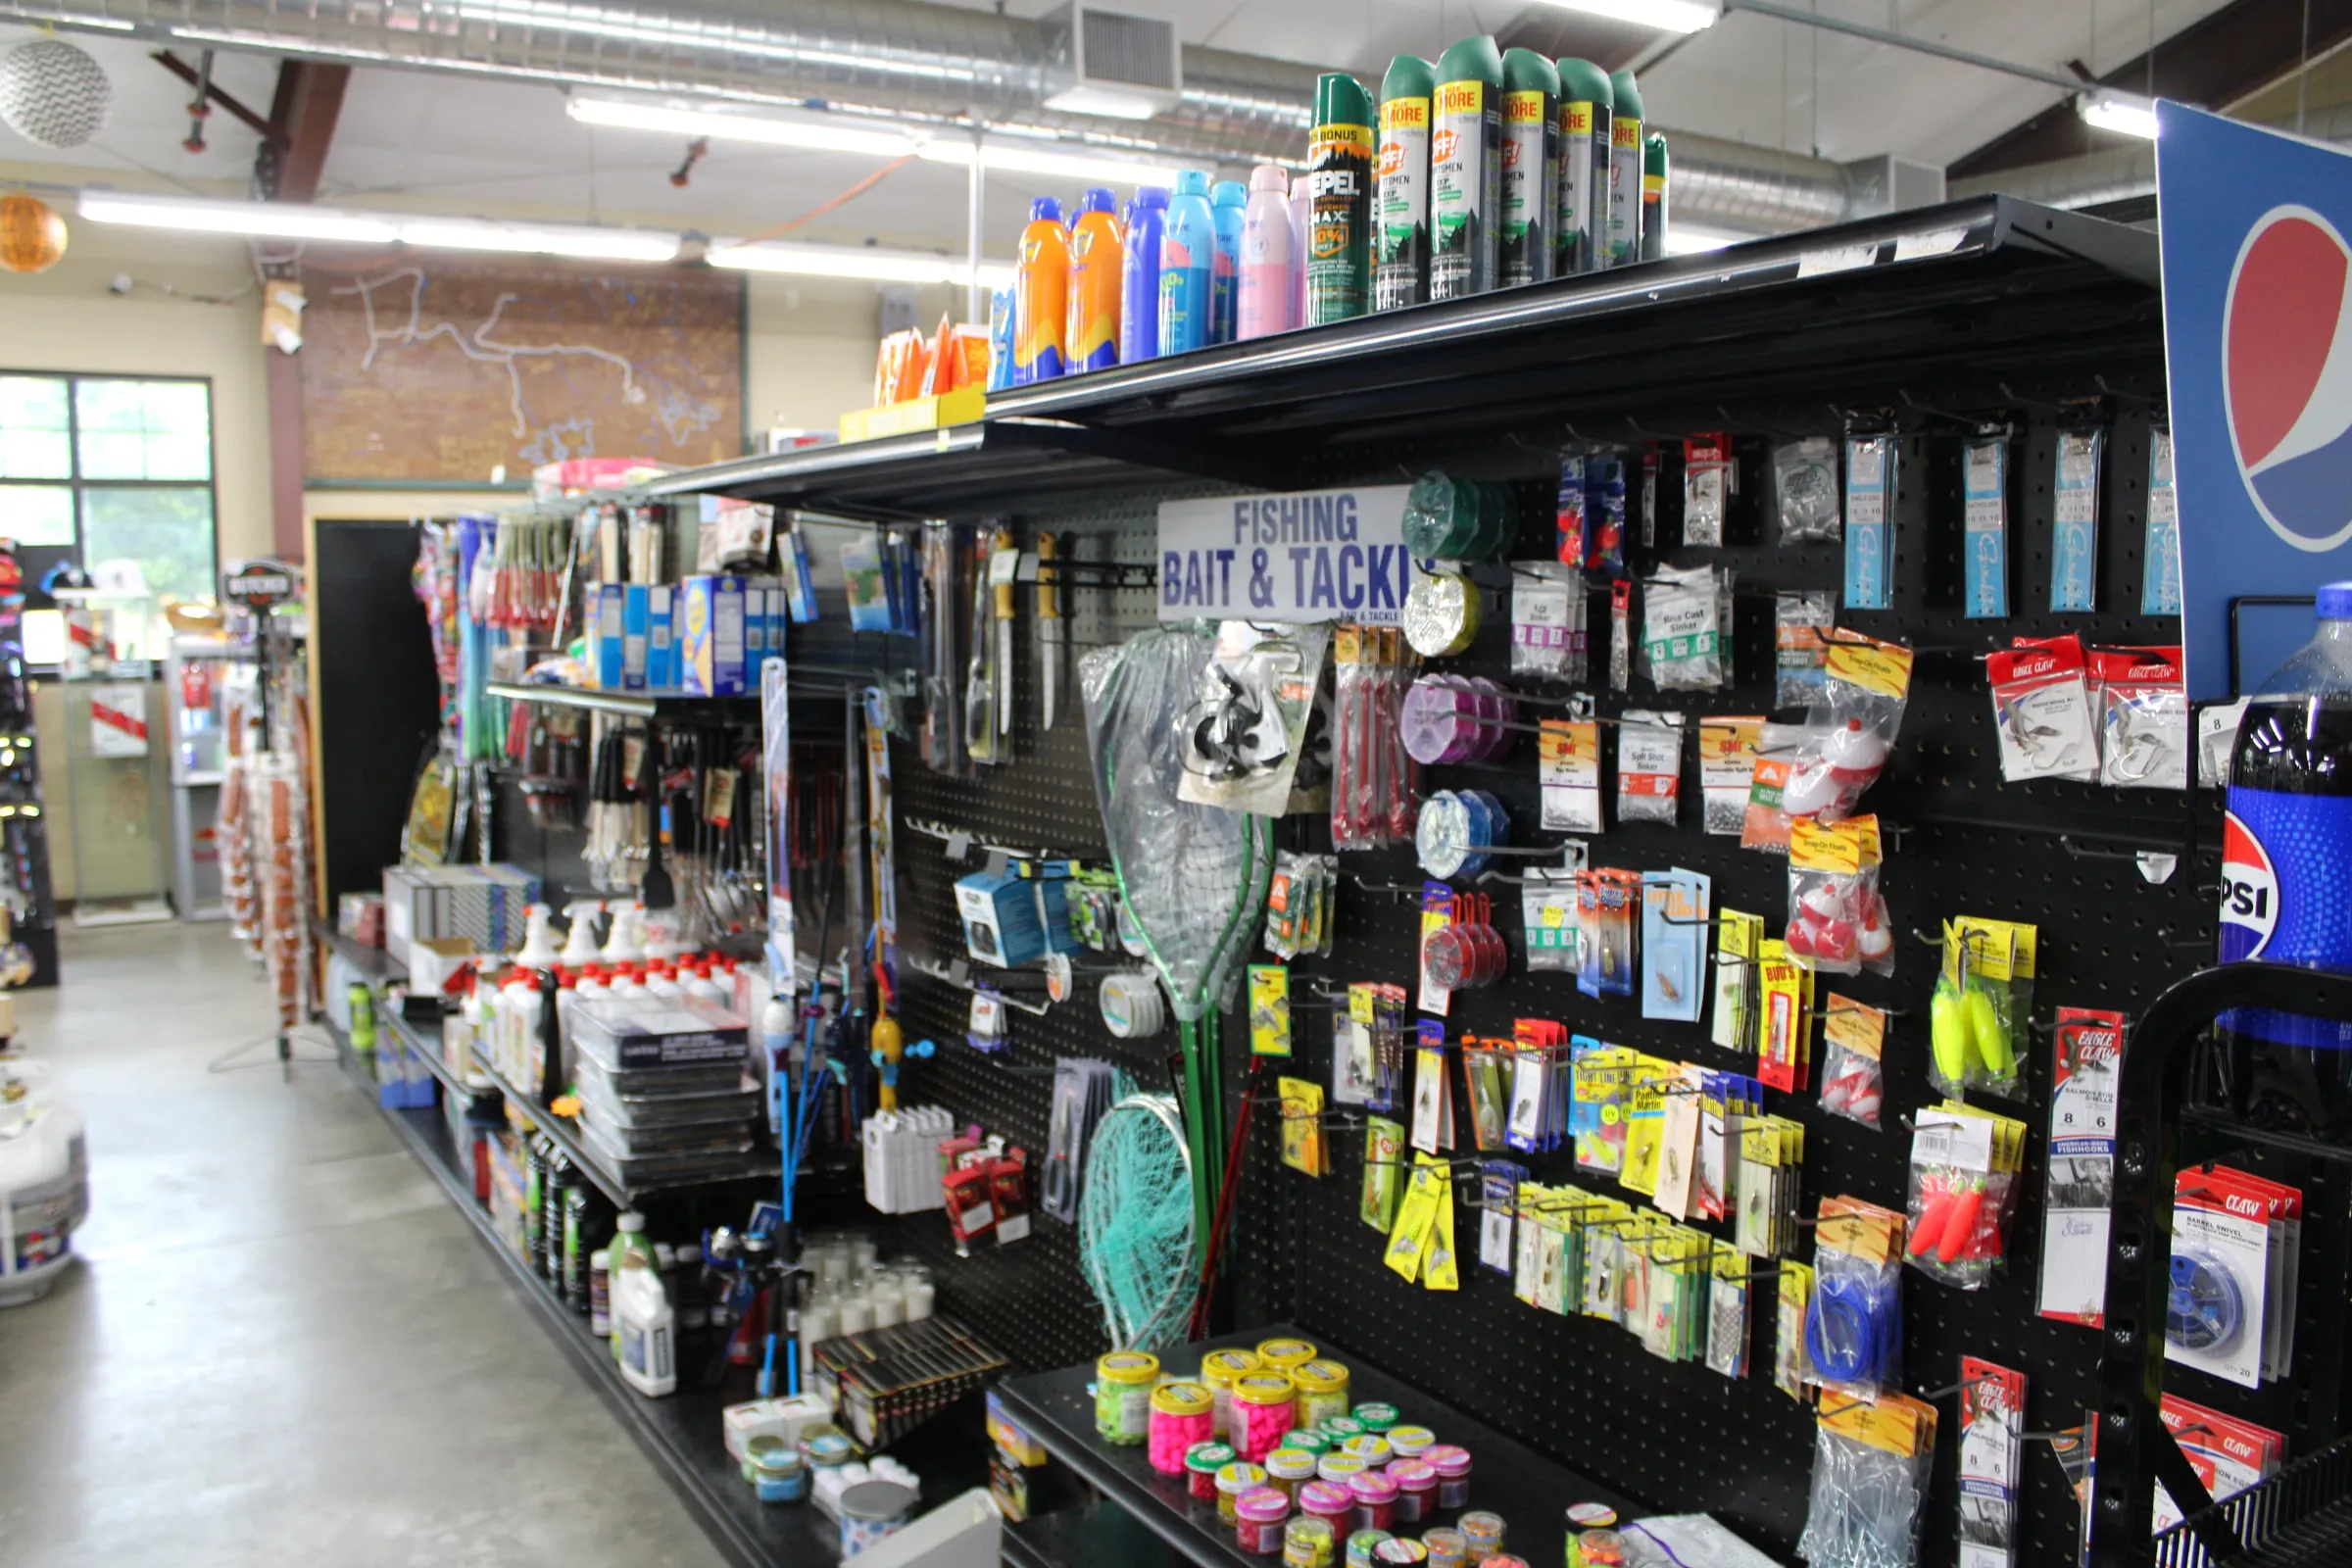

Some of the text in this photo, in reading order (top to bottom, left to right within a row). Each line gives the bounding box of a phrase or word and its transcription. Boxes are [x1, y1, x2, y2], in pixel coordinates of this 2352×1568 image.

[1559, 113, 1586, 129] ORE
[1309, 170, 1361, 197] EPEL
[1315, 228, 1343, 244] 0%
[1234, 494, 1357, 544] FISHING
[1163, 544, 1435, 610] BAIT & TACKL
[1369, 611, 1398, 621] TACKLE
[2012, 659, 2055, 679] EAGLE CLAW
[2213, 718, 2222, 730] 8
[1765, 964, 1795, 982] BUD'S
[2078, 1030, 2116, 1048] EAGLE
[2080, 1046, 2116, 1061] CLAW
[1637, 1100, 1661, 1110] Martin
[2064, 1112, 2106, 1128] 8 6
[2226, 1194, 2260, 1216] CLAW
[2186, 1215, 2243, 1237] BARREL SWIVEL
[2239, 1367, 2251, 1379] 20
[2223, 1436, 2253, 1458] CLAW
